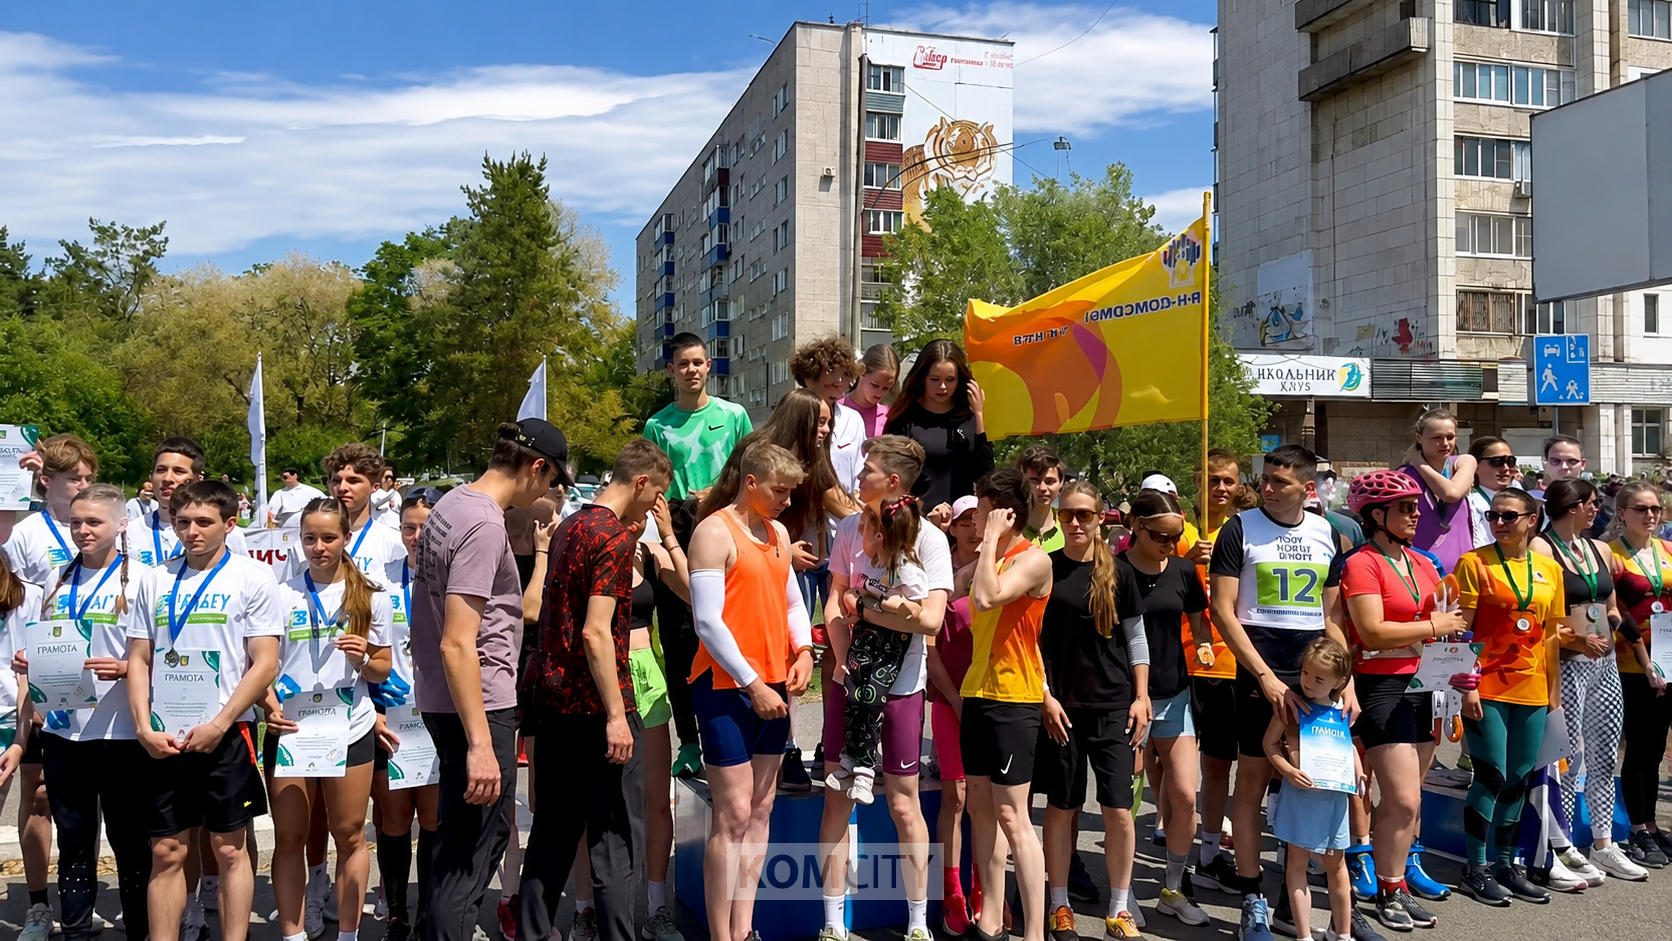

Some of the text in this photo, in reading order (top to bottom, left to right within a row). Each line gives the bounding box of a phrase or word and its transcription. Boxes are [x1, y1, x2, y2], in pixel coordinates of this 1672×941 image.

[1272, 568, 1318, 603] 12
[37, 645, 78, 655] ГРАМОТА
[164, 673, 204, 683] ГРАМОТА
